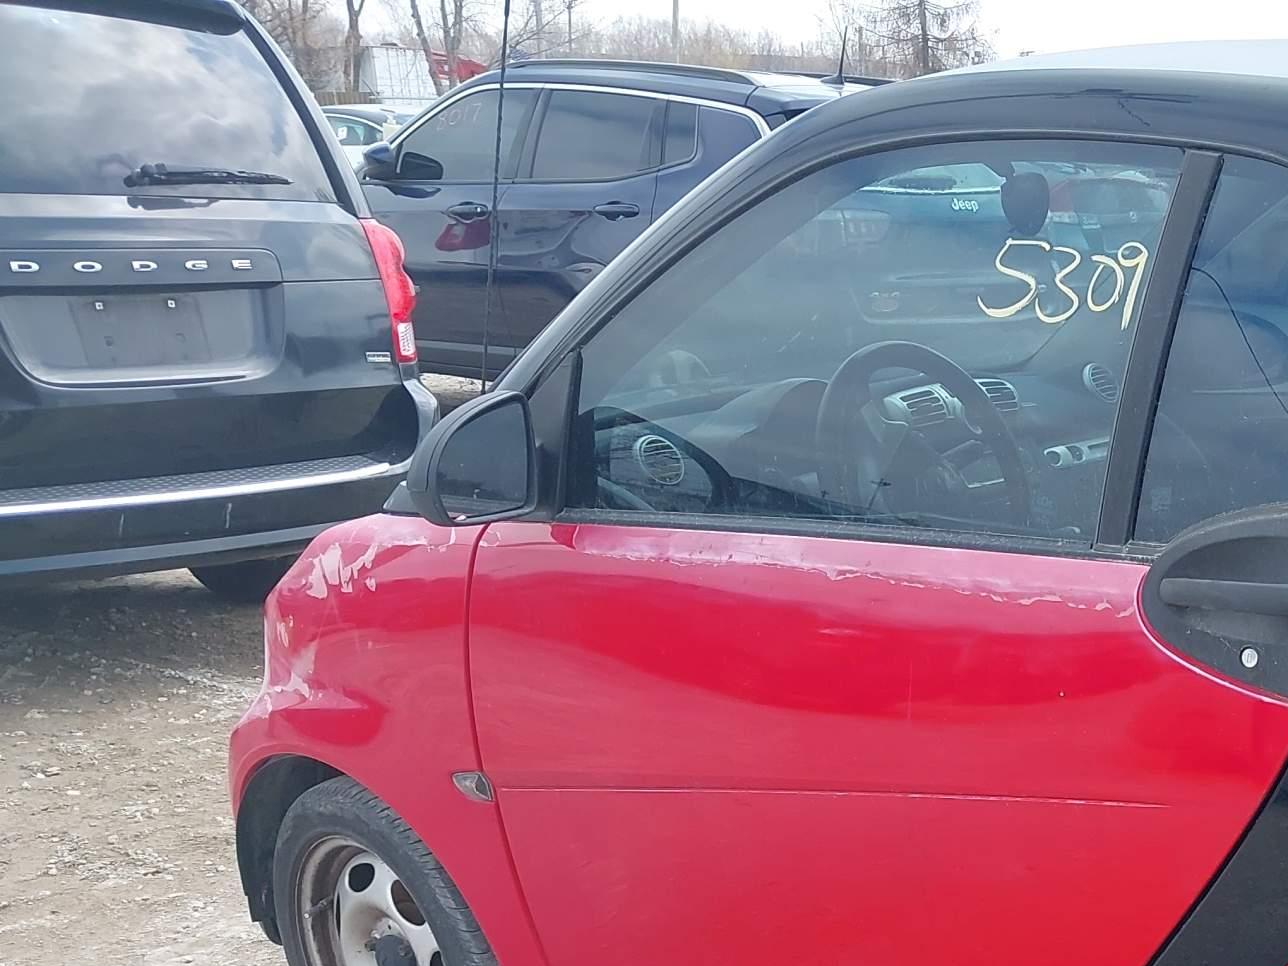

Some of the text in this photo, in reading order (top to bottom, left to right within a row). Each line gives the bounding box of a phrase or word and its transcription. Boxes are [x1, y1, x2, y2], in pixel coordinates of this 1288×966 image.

[951, 198, 979, 213] Jeep
[9, 259, 253, 273] DODGE
[977, 238, 1149, 330] 5309
